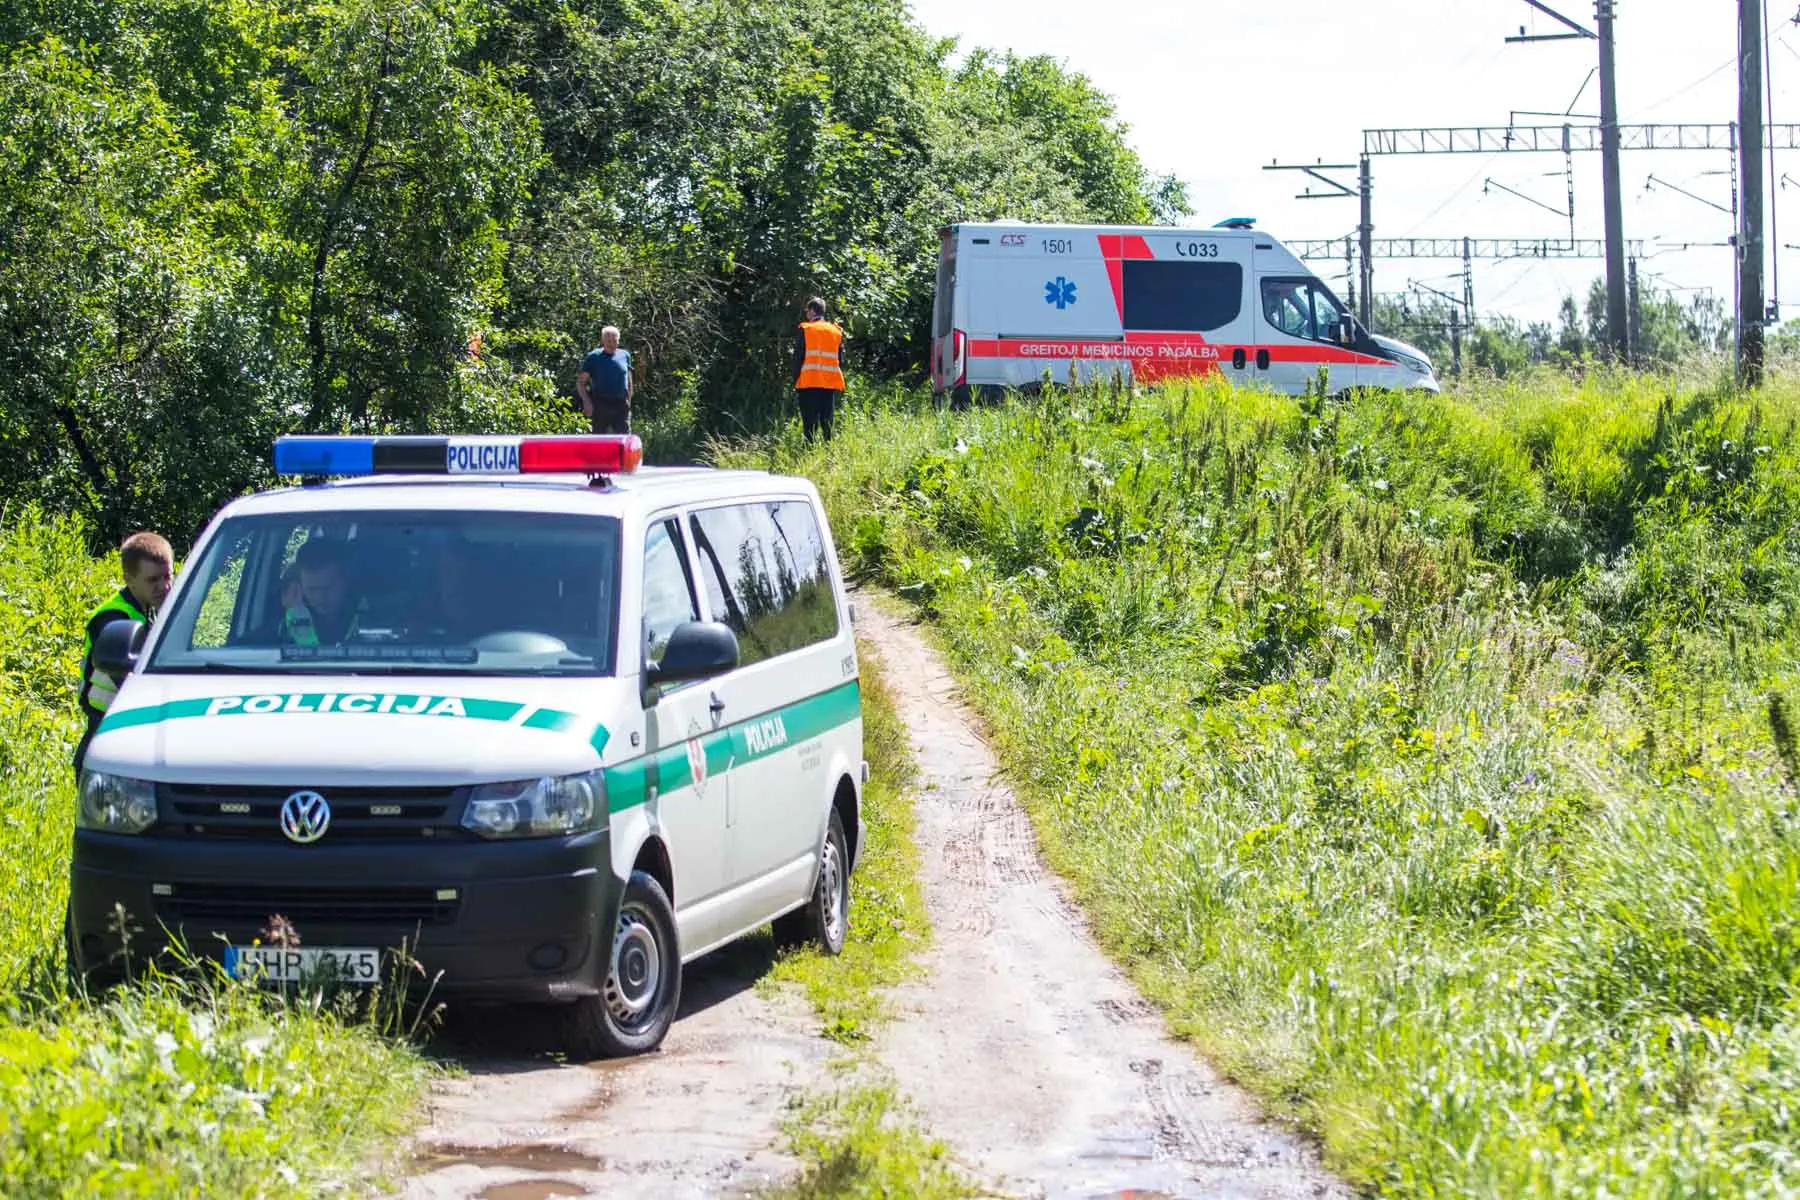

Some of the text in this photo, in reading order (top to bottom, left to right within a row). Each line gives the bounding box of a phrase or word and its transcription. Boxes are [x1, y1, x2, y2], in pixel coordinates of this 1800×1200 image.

[1041, 239, 1072, 254] 1501
[1188, 242, 1218, 257] 033
[1020, 344, 1219, 359] GREITOJI MEDICINOS PAGALBA
[448, 445, 518, 470] POLICIJA
[205, 694, 467, 716] POLICIJA
[743, 715, 788, 756] POLICIJA
